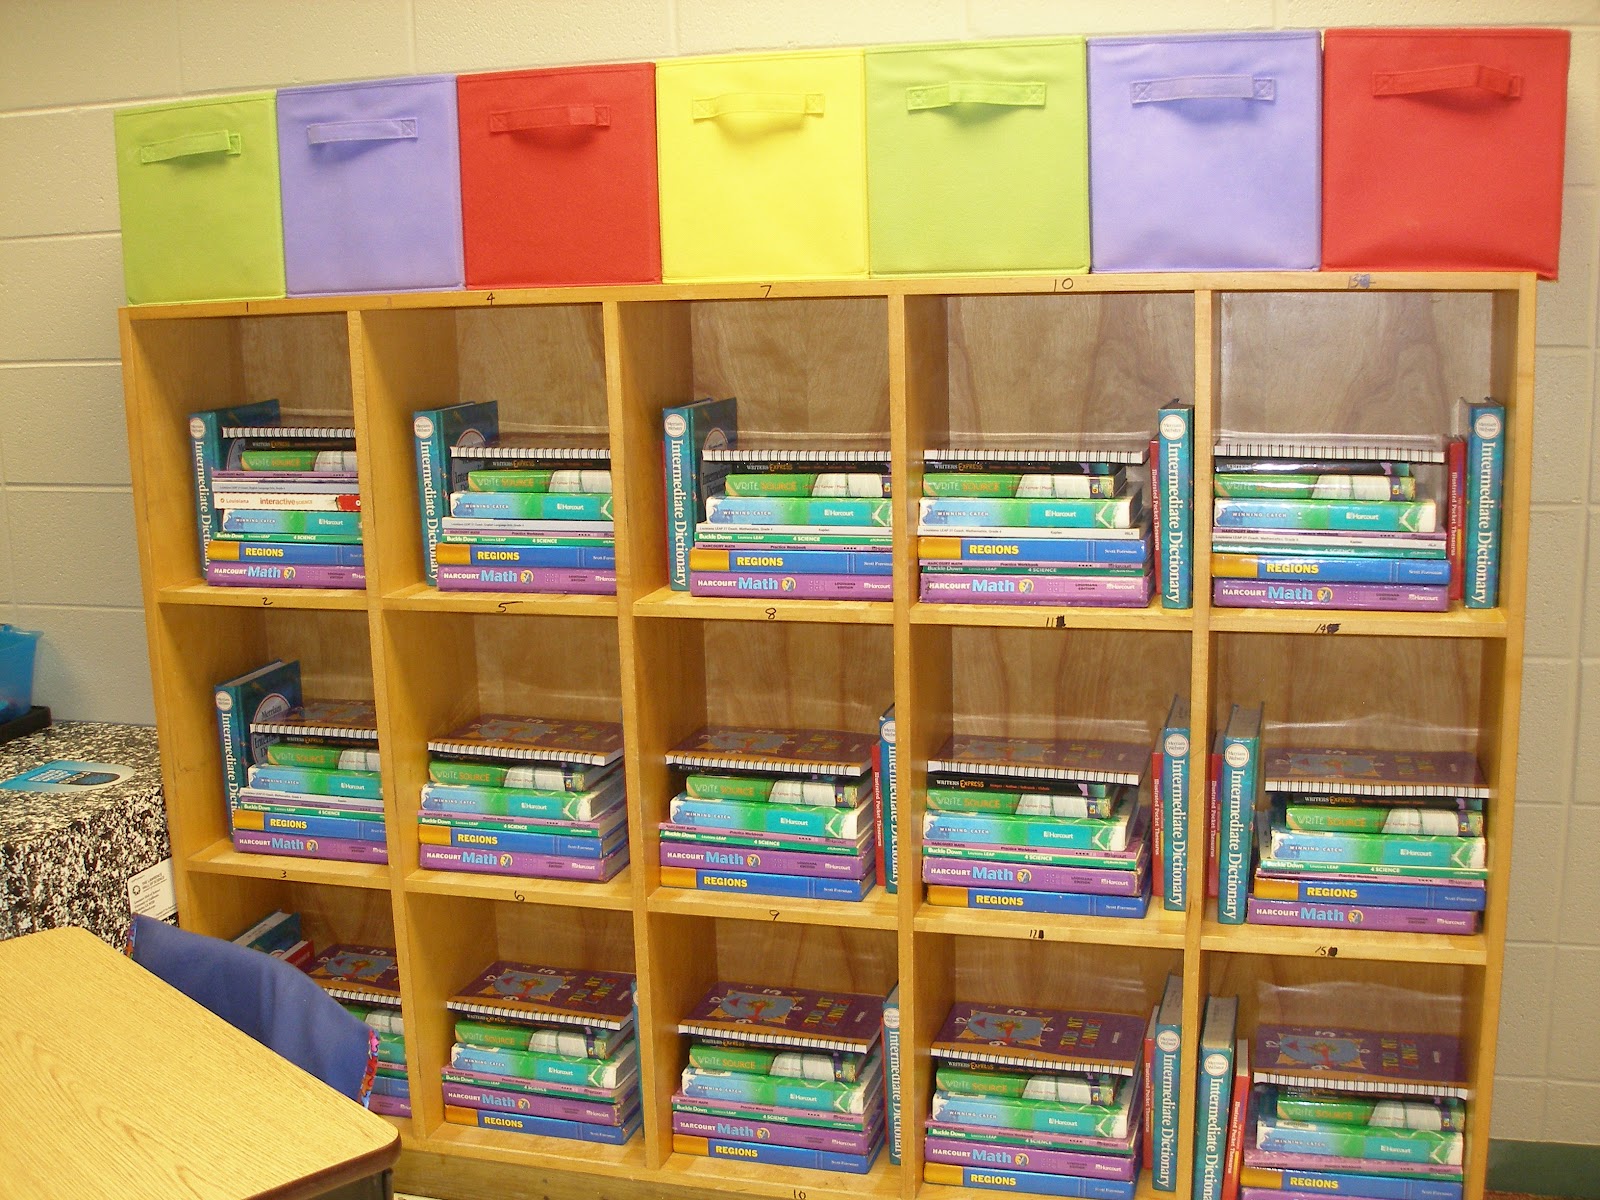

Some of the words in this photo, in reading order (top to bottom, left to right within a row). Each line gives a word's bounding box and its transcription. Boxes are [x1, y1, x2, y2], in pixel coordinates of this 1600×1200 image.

[1053, 277, 1074, 292] 10
[760, 284, 773, 299] 7
[486, 292, 496, 306] 4
[194, 441, 210, 513] Intermediate
[420, 440, 437, 516] Intermediate
[671, 440, 687, 518] Intermediate
[734, 482, 759, 490] WRITE
[761, 482, 796, 491] SOURCE
[933, 482, 960, 491] WRITE
[962, 483, 999, 492] SOURCE
[1167, 442, 1183, 529] Intermediate
[1478, 442, 1496, 530] Intermediate
[1051, 510, 1076, 518] Harcourt
[245, 548, 284, 557] REGIONS
[477, 551, 520, 560] REGIONS
[674, 520, 687, 587] Dictionary
[969, 544, 1019, 555] REGIONS
[736, 557, 784, 566] REGIONS
[1166, 532, 1183, 603] Dictionary
[1472, 532, 1492, 604] Dictionary
[248, 566, 281, 578] Math
[1266, 563, 1319, 574] REGIONS
[481, 570, 518, 583] Math
[738, 577, 779, 590] Math
[929, 582, 970, 590] HARCOURT
[972, 579, 1015, 592] Math
[1112, 583, 1135, 591] Harcourt
[1222, 588, 1266, 597] HARCOURT
[1268, 586, 1312, 600] Math
[1414, 594, 1439, 602] Harcourt
[262, 596, 274, 606] 2
[765, 607, 777, 620] 8
[221, 713, 237, 781] Intermediate
[459, 772, 490, 782] SOURCE
[936, 779, 959, 787] WRITERS
[960, 779, 984, 788] EXPRESS
[694, 784, 717, 793] WRITE
[720, 786, 754, 796] SOURCE
[936, 796, 962, 806] WRITE
[963, 798, 1000, 808] SOURCE
[1171, 759, 1186, 840] Intermediate
[1228, 769, 1246, 855] Intermediate
[270, 818, 307, 829] REGIONS
[1296, 816, 1324, 825] WRITE
[1326, 817, 1366, 826] SOURCE
[457, 834, 498, 845] REGIONS
[1049, 831, 1074, 839] Harcourt
[272, 838, 304, 850] Math
[426, 852, 461, 861] HARCOURT
[462, 852, 497, 865] Math
[667, 852, 704, 860] HARCOURT
[705, 852, 744, 865] Math
[1406, 849, 1432, 857] Harcourt
[280, 869, 288, 879] 3
[931, 868, 971, 876] HARCOURT
[972, 866, 1013, 881] Math
[1171, 841, 1186, 907] Dictionary
[704, 876, 748, 887] REGIONS
[1106, 878, 1129, 887] Harcourt
[1222, 857, 1242, 920] Dictionary
[1307, 887, 1358, 899] REGIONS
[976, 894, 1024, 906] REGIONS
[769, 909, 780, 921] 9
[1256, 908, 1299, 917] HARCOURT
[1300, 907, 1344, 922] Math
[1058, 1016, 1084, 1052] STUDNT
[722, 1059, 755, 1069] SOURCE
[889, 1031, 900, 1104] Intermediate
[972, 1082, 1007, 1093] SOURCE
[1161, 1053, 1176, 1126] Intermediate
[448, 1092, 481, 1102] HARCOURT
[482, 1094, 516, 1108] Math
[1206, 1077, 1224, 1151] Intermediate
[484, 1116, 524, 1128] REGIONS
[1055, 1118, 1078, 1127] Harcourt
[680, 1122, 716, 1132] HARCOURT
[717, 1123, 753, 1138] Math
[715, 1145, 758, 1158] REGIONS
[932, 1148, 971, 1158] HARCOURT
[971, 1149, 1012, 1164] Math
[1157, 1128, 1174, 1188] Dictionary
[970, 1173, 1017, 1186] REGIONS
[1203, 1151, 1218, 1200] Dictiona
[1290, 1176, 1339, 1189] REGIONS
